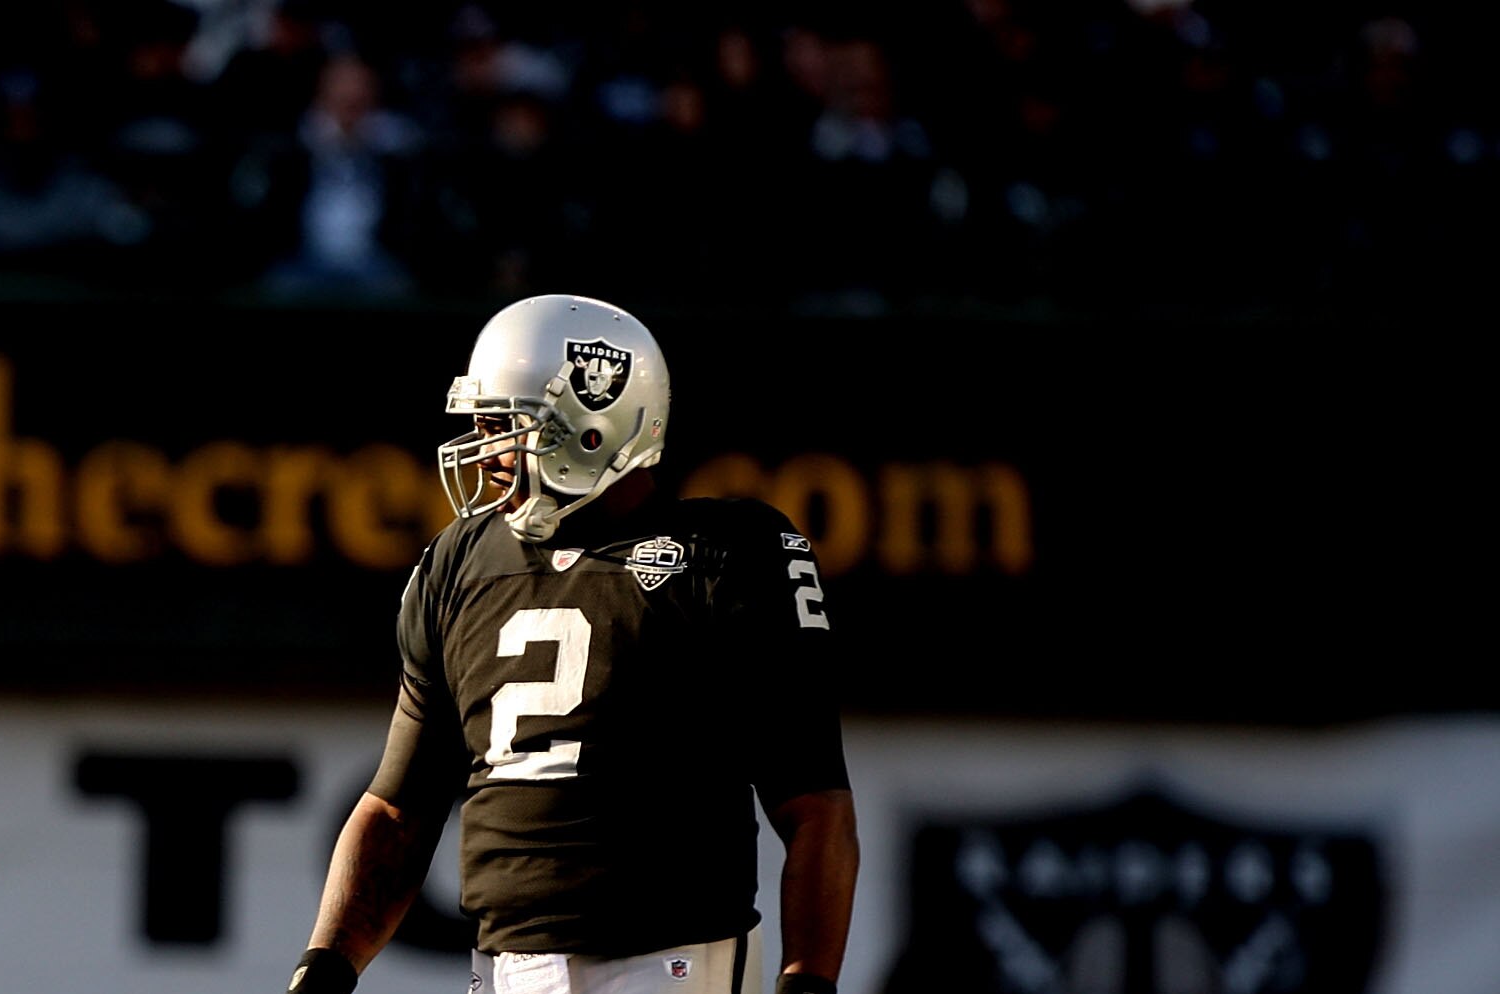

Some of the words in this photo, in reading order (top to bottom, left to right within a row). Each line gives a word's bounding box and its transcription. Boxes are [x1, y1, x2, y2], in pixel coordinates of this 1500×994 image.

[572, 343, 627, 361] RAIDERS
[636, 547, 678, 566] 50
[788, 559, 830, 630] 2
[485, 608, 592, 780] 2
[72, 751, 468, 952] T
